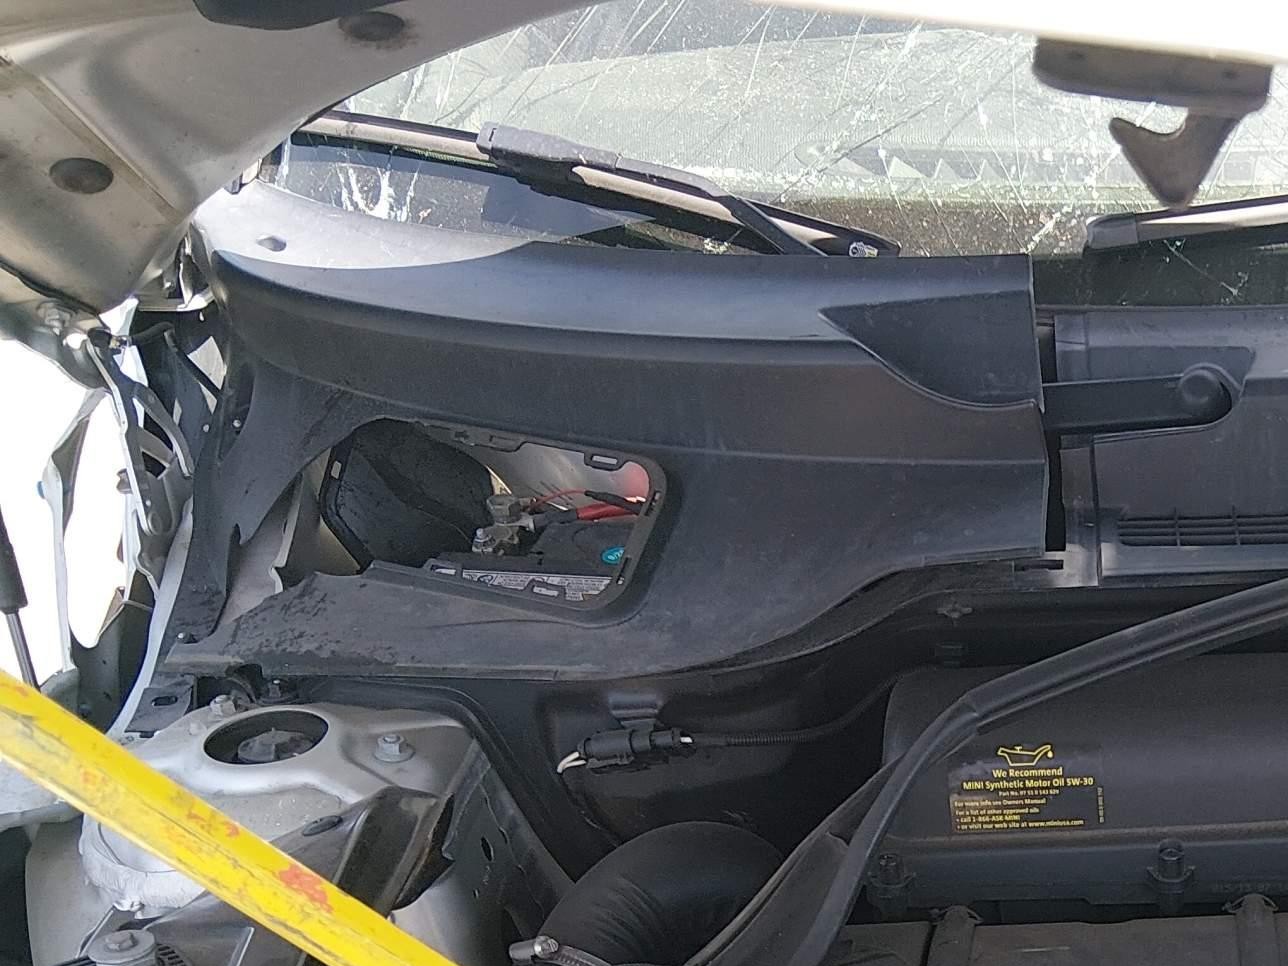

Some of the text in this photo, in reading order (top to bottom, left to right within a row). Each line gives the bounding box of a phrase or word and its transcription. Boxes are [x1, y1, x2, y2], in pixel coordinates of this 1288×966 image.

[992, 766, 1063, 778] We Recommend
[963, 777, 1093, 791] MINI Synthetic Motor Oil 5W-30
